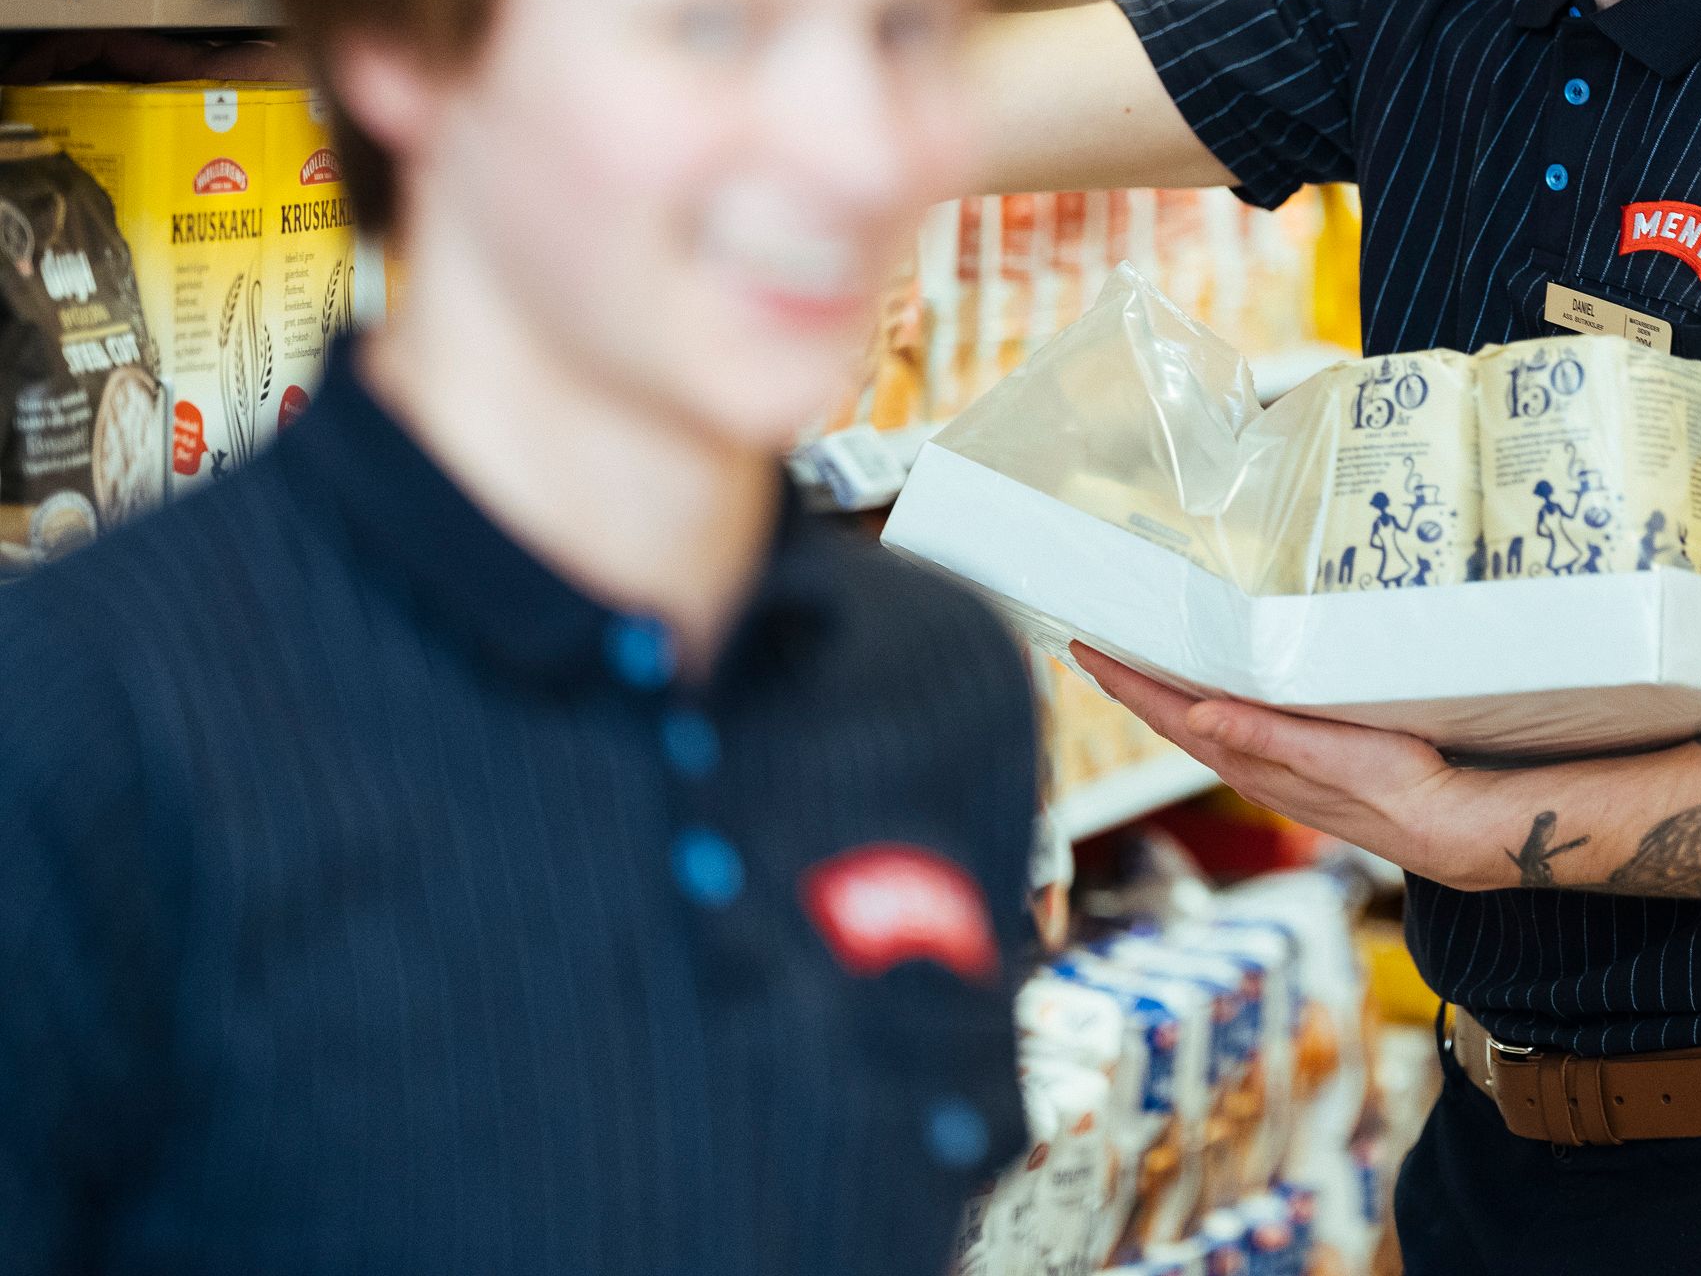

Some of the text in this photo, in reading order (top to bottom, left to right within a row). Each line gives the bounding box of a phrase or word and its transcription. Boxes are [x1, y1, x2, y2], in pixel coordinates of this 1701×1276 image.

[1572, 298, 1595, 317] DANIEL
[1351, 373, 1428, 430] 150
[1507, 358, 1584, 419] 150
